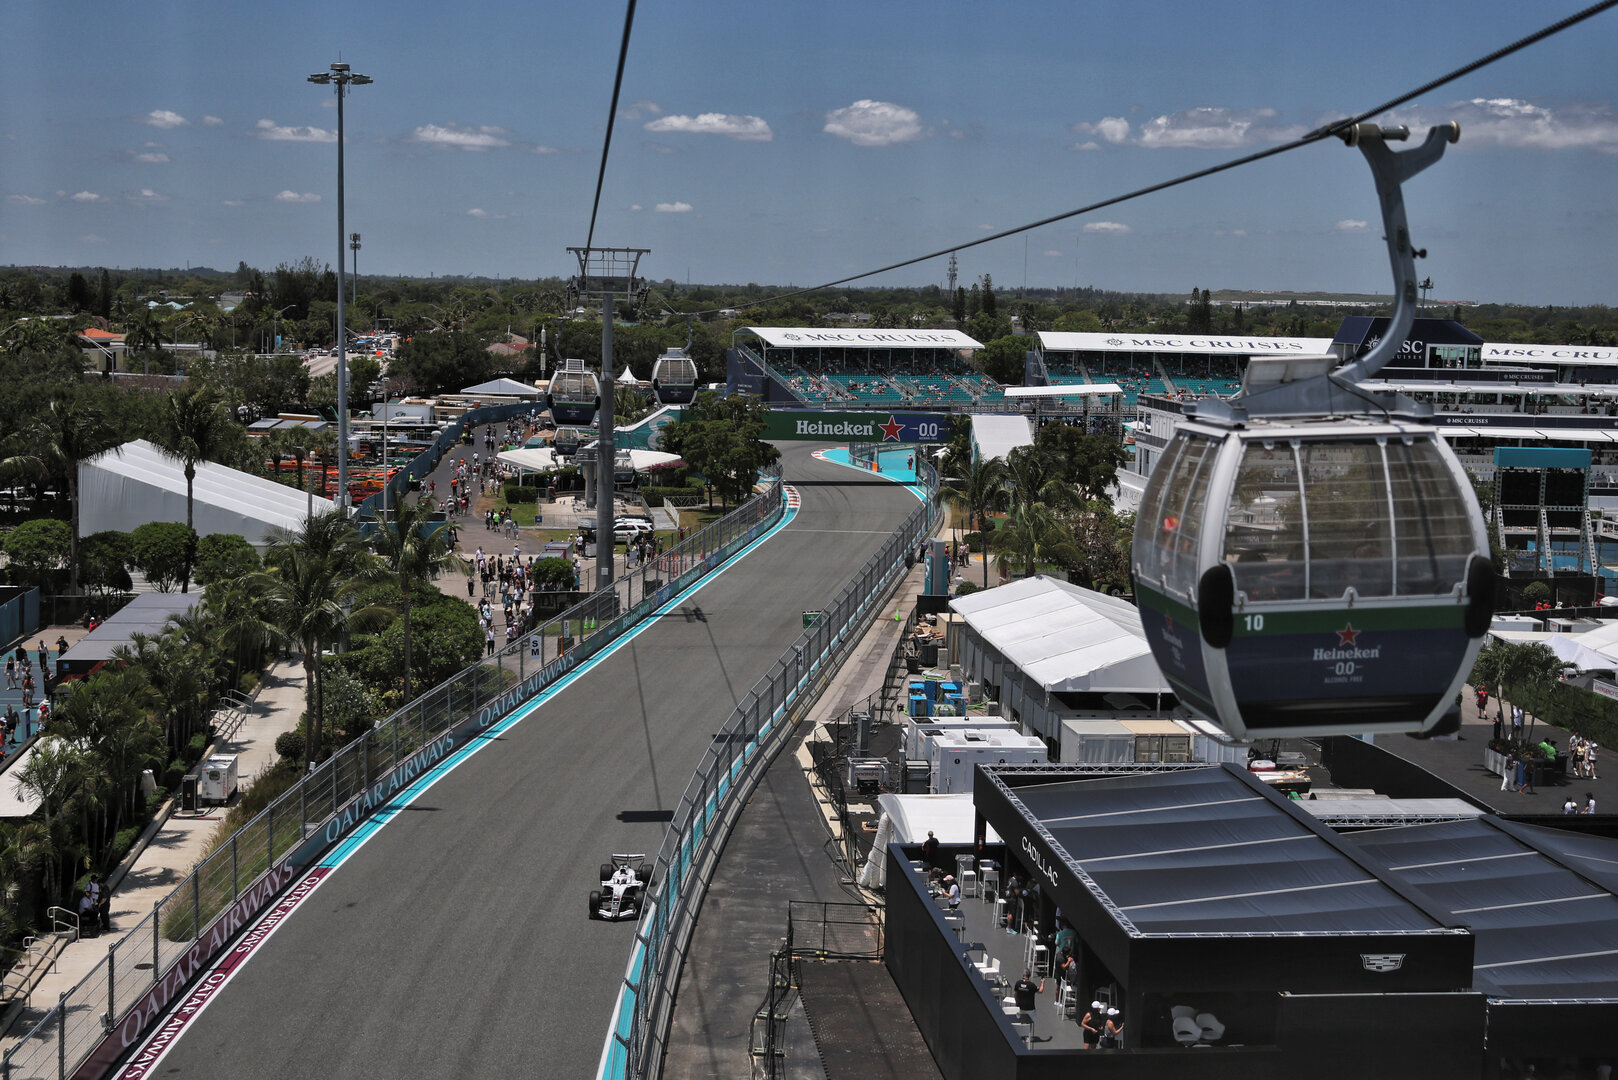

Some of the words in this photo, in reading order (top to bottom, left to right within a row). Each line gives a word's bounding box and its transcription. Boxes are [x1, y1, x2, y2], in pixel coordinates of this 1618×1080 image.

[805, 332, 855, 343] MSC
[857, 333, 957, 343] CRUISES
[1132, 338, 1182, 348] MSC
[1189, 340, 1303, 350] CRUISES
[1397, 340, 1423, 353] SC
[1489, 348, 1544, 357] MSC
[1552, 349, 1618, 359] CRU
[796, 420, 874, 436] Heineken
[918, 422, 938, 437] 0.0
[1244, 614, 1264, 631] 10
[1313, 647, 1380, 661] Heineken
[1335, 661, 1355, 676] 0.0
[479, 687, 524, 727] QATAR
[526, 651, 575, 696] AIRWAYS
[325, 783, 385, 844] QATAR
[388, 731, 454, 795] AIRWAYS
[1022, 836, 1058, 887] CADILLAC
[279, 876, 320, 908] QATAR
[236, 908, 286, 953] AIRWAYS
[121, 943, 201, 1048] QATAR
[207, 856, 294, 959] AIRWAYS
[182, 973, 226, 1015] QATAR
[125, 1017, 185, 1079] AIRWAYS
